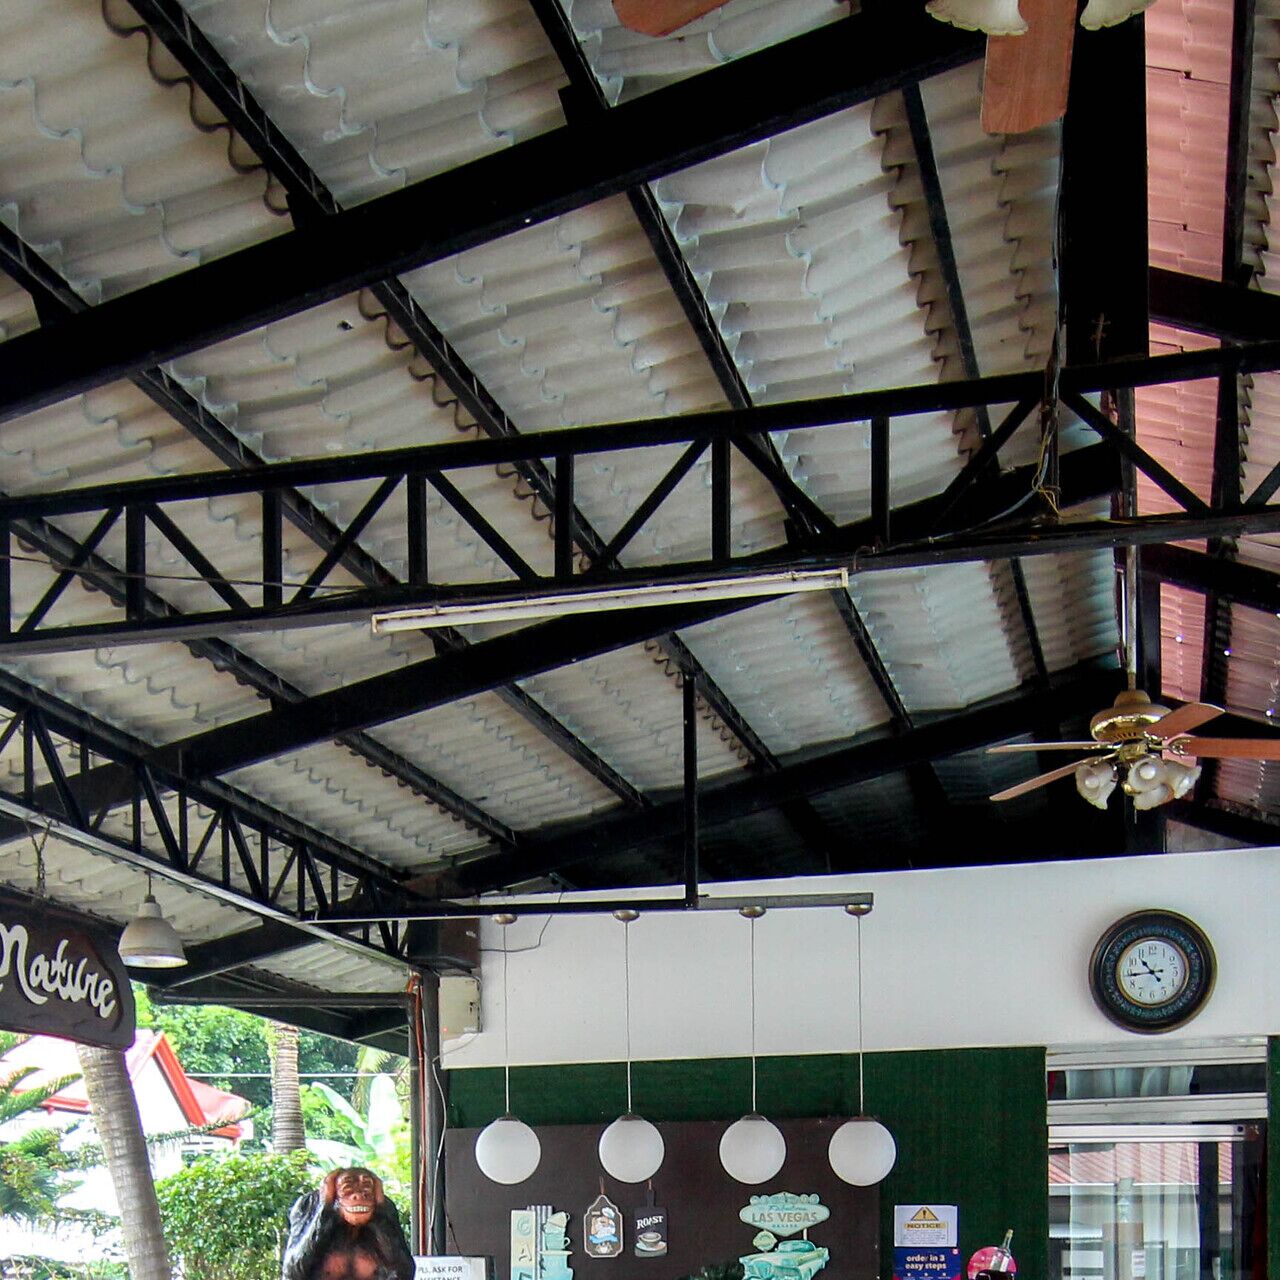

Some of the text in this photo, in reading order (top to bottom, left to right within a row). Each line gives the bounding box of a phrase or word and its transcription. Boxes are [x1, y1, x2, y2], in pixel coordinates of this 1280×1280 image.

[905, 966, 1178, 1262] order in 3
[751, 1211, 818, 1223] LAS VEGAS
[636, 1215, 664, 1230] ROAST
[906, 1222, 941, 1230] NOTICE
[432, 1266, 447, 1274] ASK
[448, 1265, 463, 1273] FOR
[905, 1262, 947, 1271] easy steps
